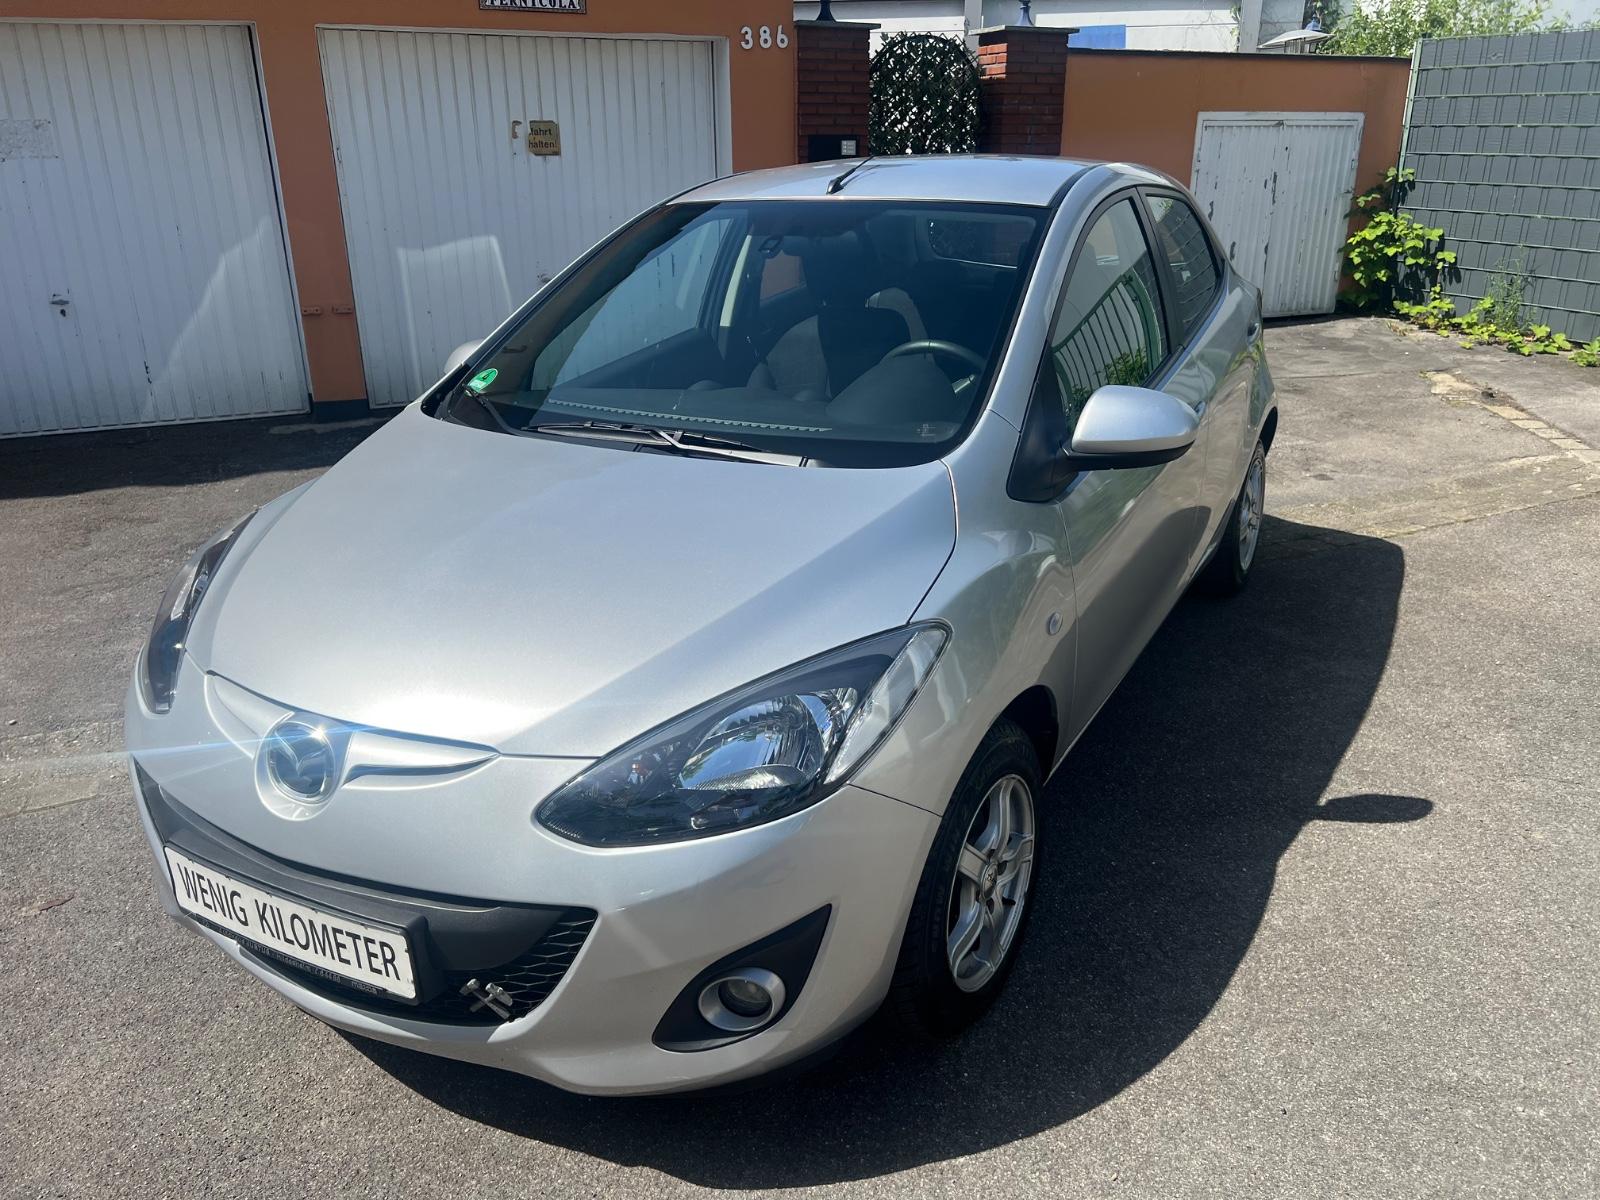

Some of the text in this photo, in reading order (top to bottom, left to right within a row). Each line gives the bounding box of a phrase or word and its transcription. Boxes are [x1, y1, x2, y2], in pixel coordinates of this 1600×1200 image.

[740, 24, 789, 50] 386
[177, 862, 401, 981] WENIG KILOMETER
